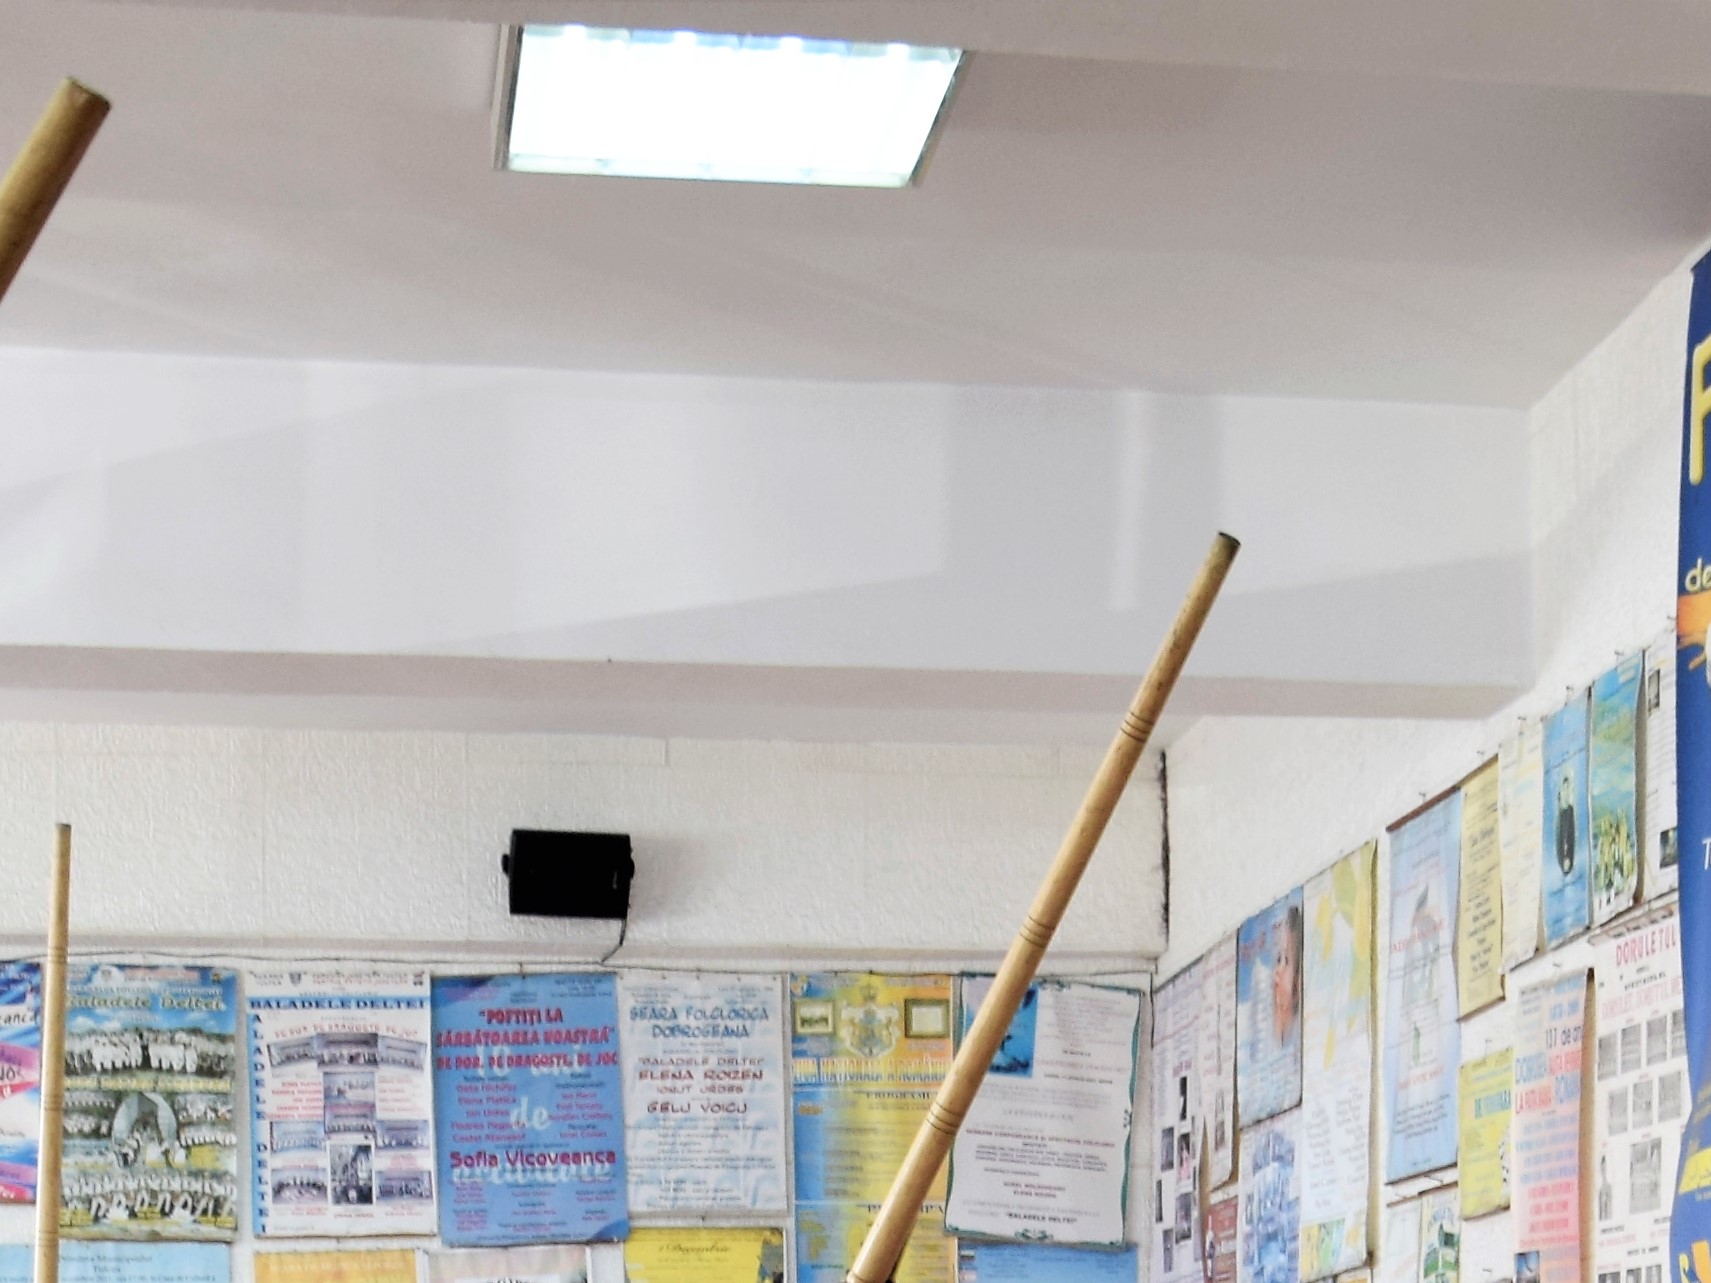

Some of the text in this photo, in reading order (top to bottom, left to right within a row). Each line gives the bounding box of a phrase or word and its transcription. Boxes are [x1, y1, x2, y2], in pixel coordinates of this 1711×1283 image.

[250, 1000, 425, 1010] BALADELE DELTEI
[545, 1008, 563, 1023] LA
[630, 1007, 677, 1021] SEARA
[639, 1070, 694, 1081] ELENA
[647, 1102, 748, 1114] GELU VOICU
[450, 1150, 616, 1168] Sofia Vicoveanca
